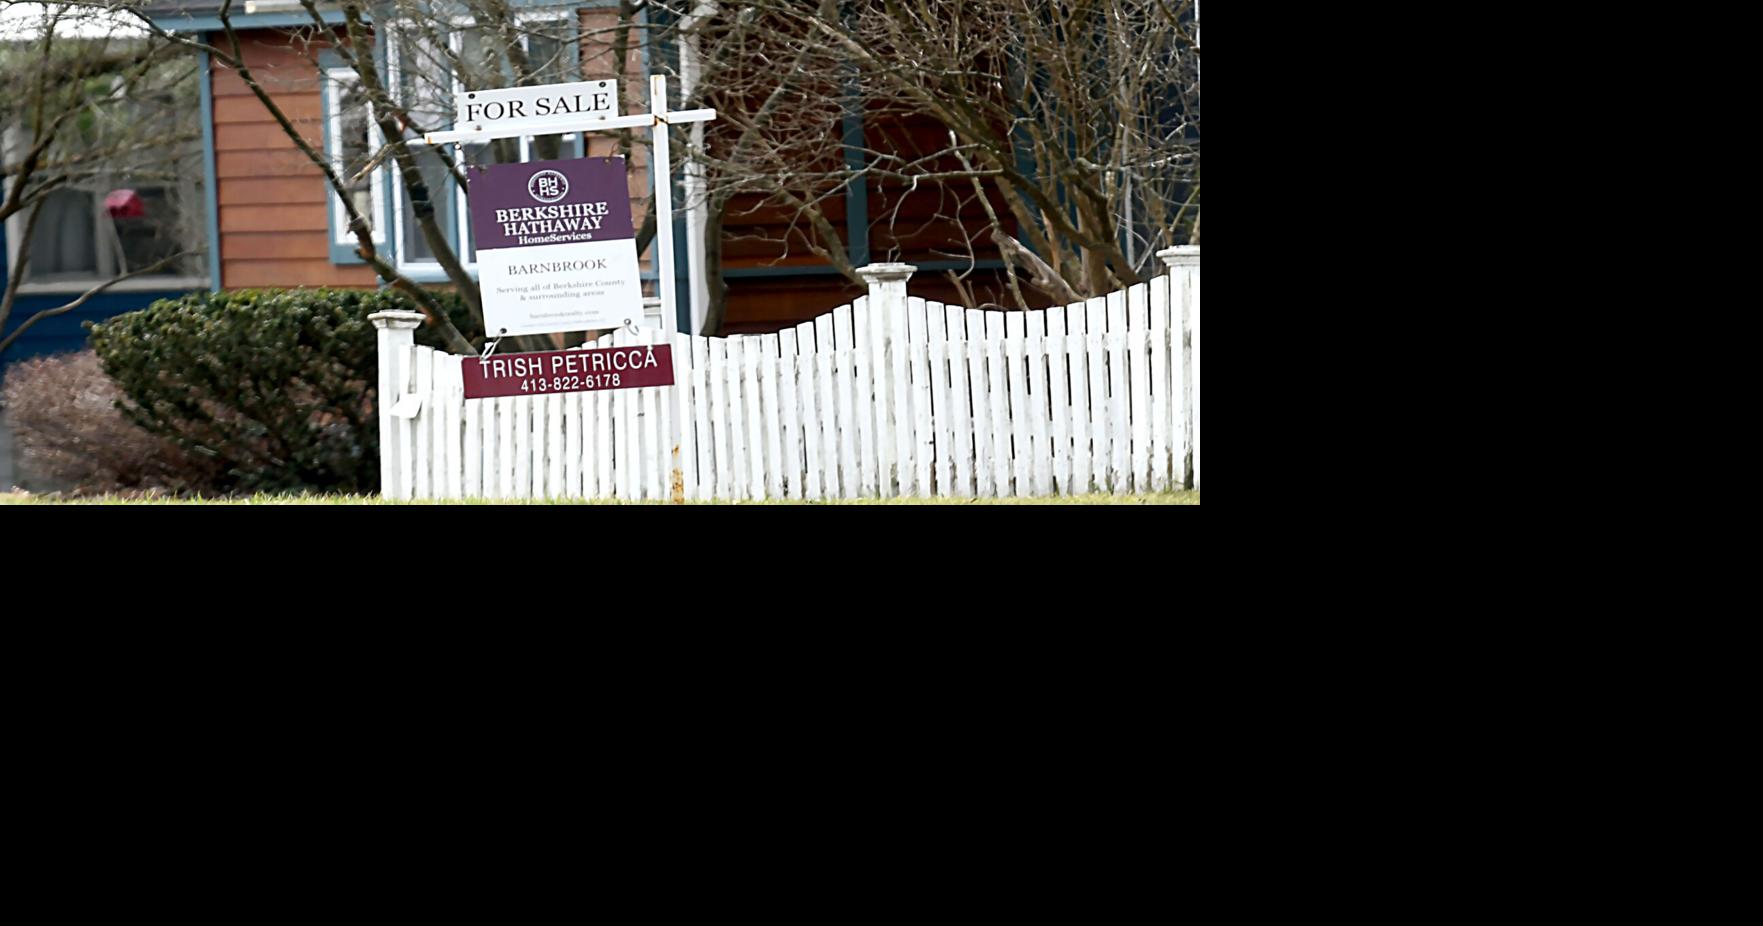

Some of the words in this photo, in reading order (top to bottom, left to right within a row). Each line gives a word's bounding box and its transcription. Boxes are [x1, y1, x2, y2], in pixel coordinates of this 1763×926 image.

[466, 100, 528, 122] FOR
[535, 92, 610, 116] SALE
[538, 176, 558, 188] BH
[539, 186, 560, 197] HS
[496, 202, 609, 223] BERKSHIRE
[504, 216, 603, 237] HATHAWAY
[518, 231, 593, 245] HomeServices
[507, 258, 608, 276] BARNBROOK
[496, 286, 529, 295] Serving
[530, 284, 541, 292] all
[553, 280, 593, 290] Berkshire
[595, 279, 626, 289] County
[529, 290, 581, 300] surrounding
[582, 289, 605, 297] areas
[480, 356, 543, 379] TRISH
[551, 350, 658, 374] PETRICCA
[521, 373, 621, 392] 413-822-6178
